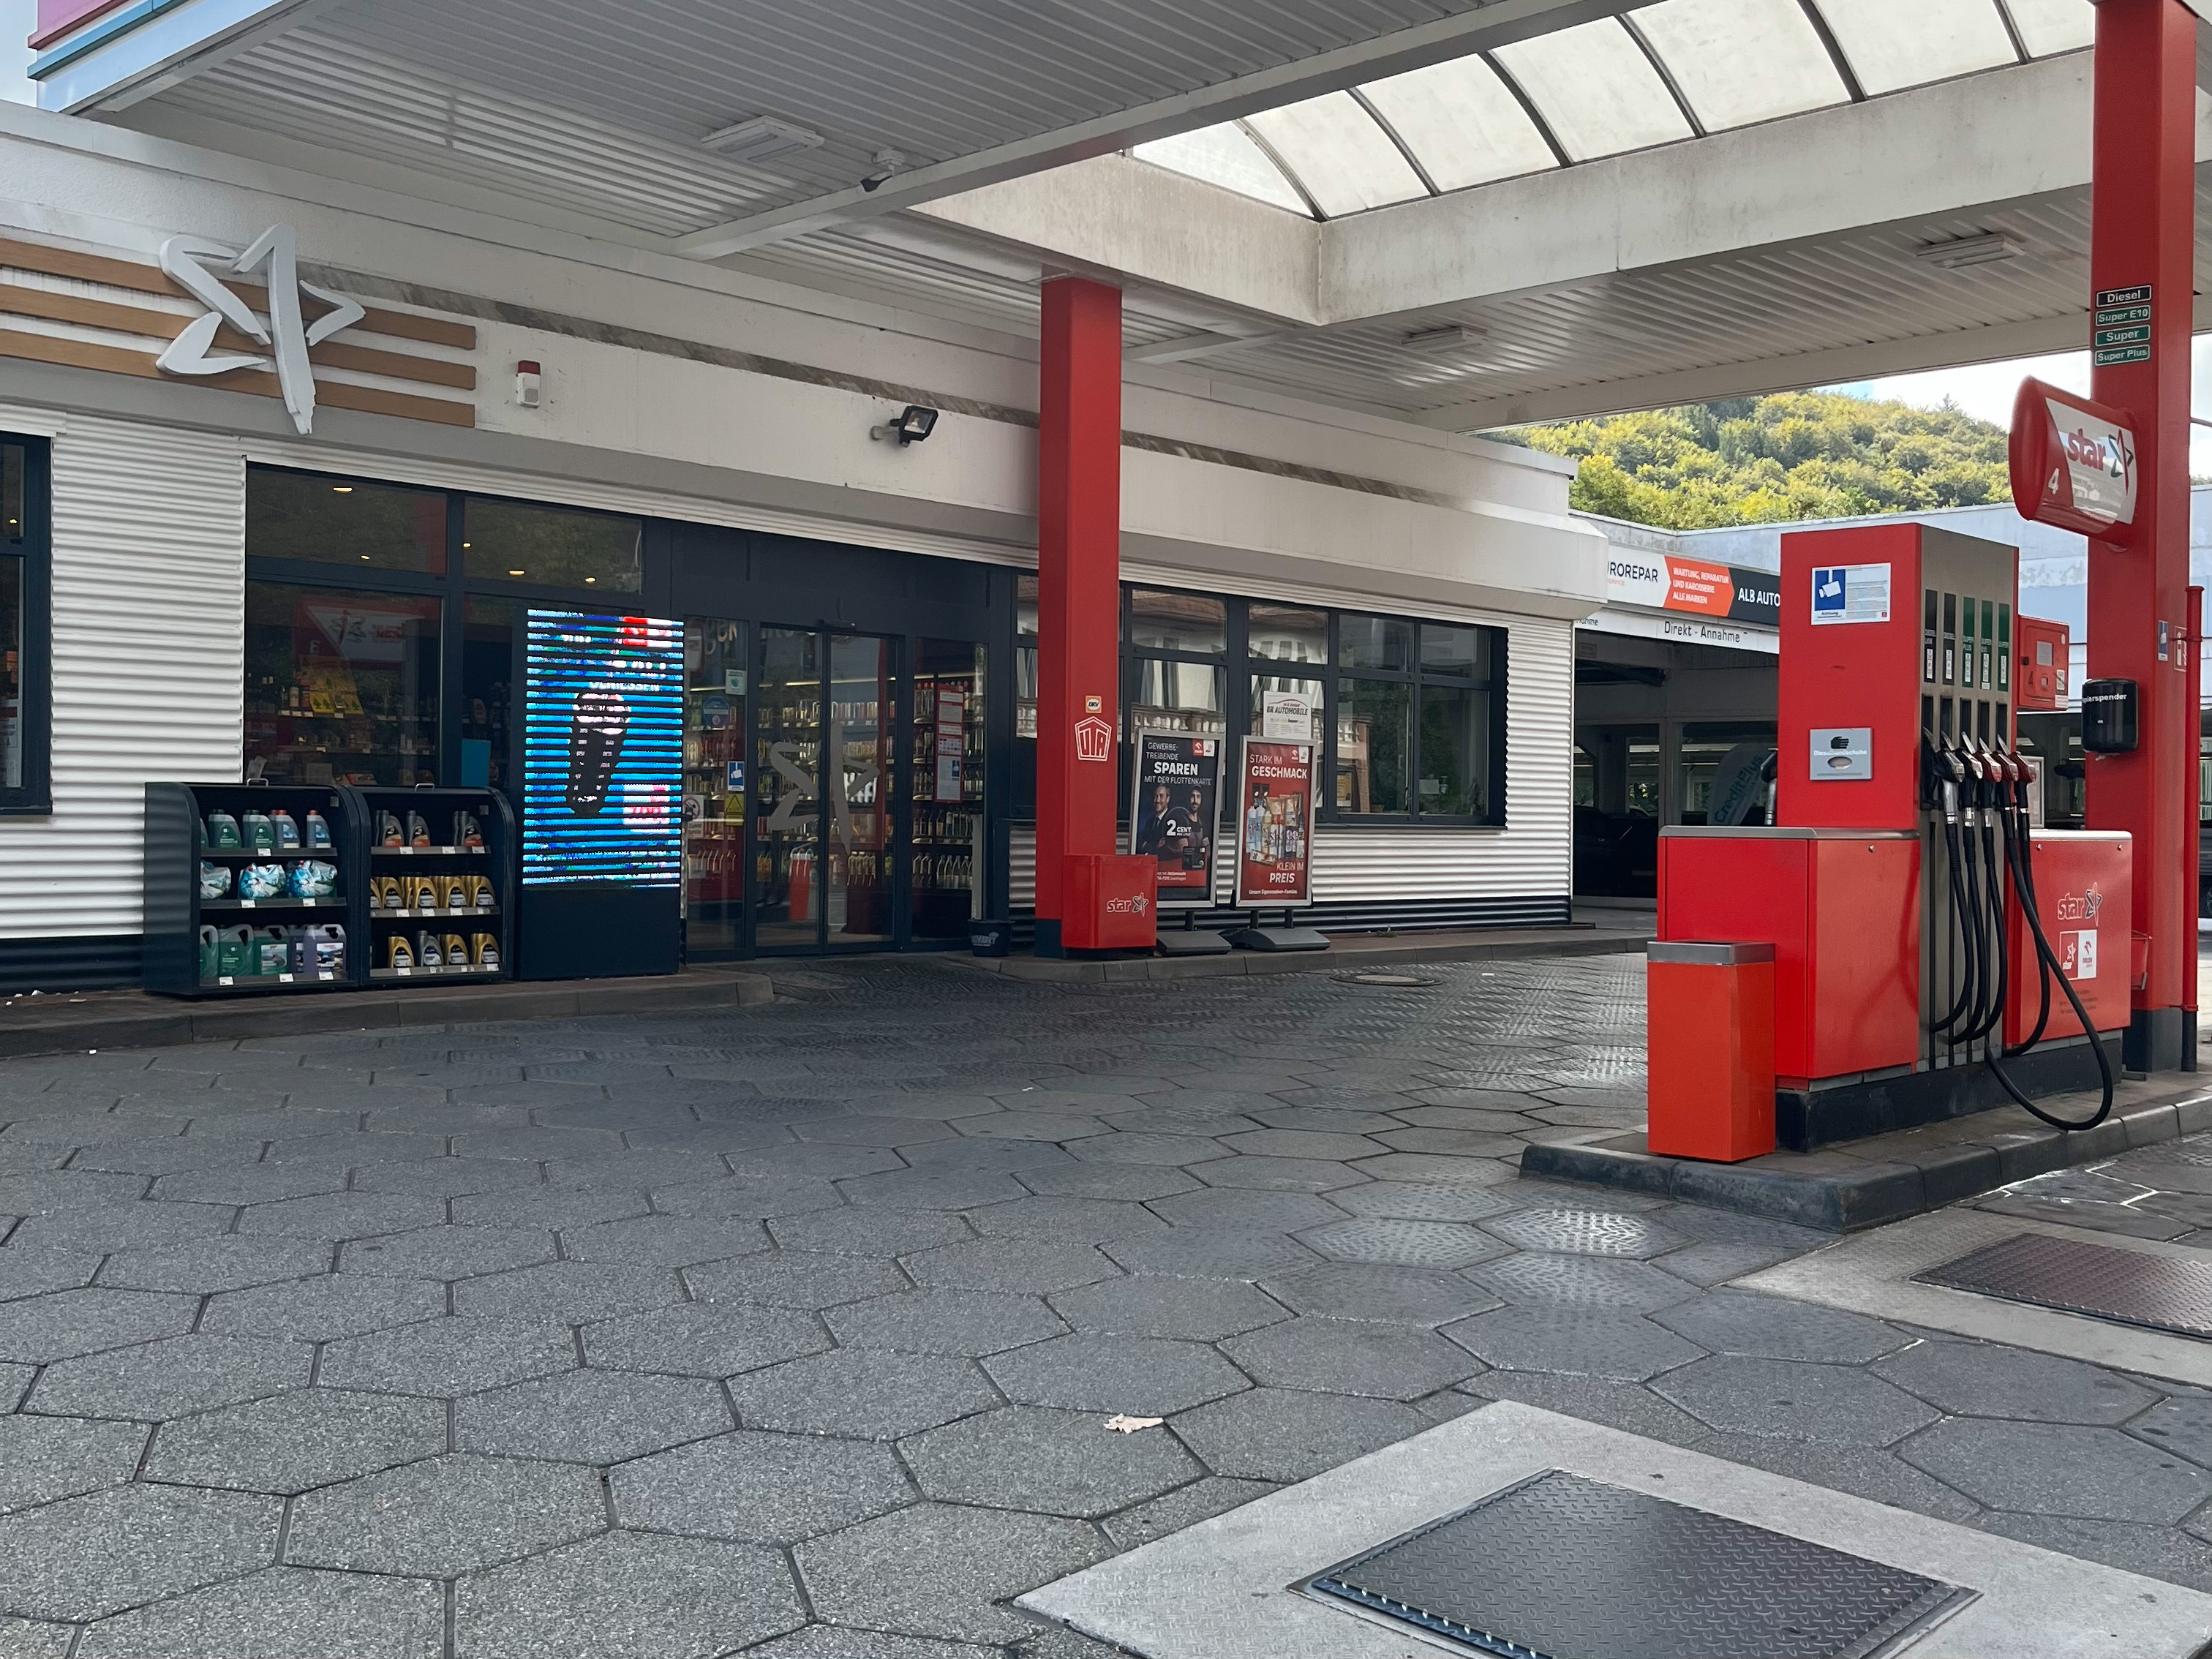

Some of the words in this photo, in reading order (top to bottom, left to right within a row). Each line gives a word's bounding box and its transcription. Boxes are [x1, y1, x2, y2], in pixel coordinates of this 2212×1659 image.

[2107, 289, 2141, 303] Diesel
[2099, 312, 2128, 323] Super
[2129, 308, 2148, 318] E10
[2107, 330, 2140, 343] Super
[2097, 352, 2126, 361] Super
[2126, 349, 2148, 358] Plus
[2067, 428, 2107, 471] star
[2048, 468, 2059, 494] 4
[1607, 560, 1658, 582] ROREPAR
[1701, 571, 1729, 584] REPARATUR
[1672, 579, 1685, 588] UND
[1672, 591, 1686, 601] ALLE
[1686, 593, 1708, 604] MARKEN
[1738, 587, 1756, 603] ALB
[1756, 590, 1780, 607] AUTO
[1664, 620, 1692, 636] Direkt
[1700, 625, 1740, 643] Annahme
[2082, 693, 2127, 704] pierspender
[1275, 707, 1309, 716] AUTOMOBILE
[1146, 751, 1179, 761] TREIBENDE
[1249, 753, 1273, 764] STARK
[1274, 756, 1283, 765] IM
[1154, 761, 1199, 775] SPAREN
[1252, 765, 1308, 779] GESCHMACK
[1166, 819, 1177, 836] 2
[1276, 862, 1296, 871] KLEIN
[1296, 862, 1304, 870] IM
[1269, 872, 1295, 884] PREIS
[1107, 897, 1132, 913] star
[2058, 892, 2085, 920] star
